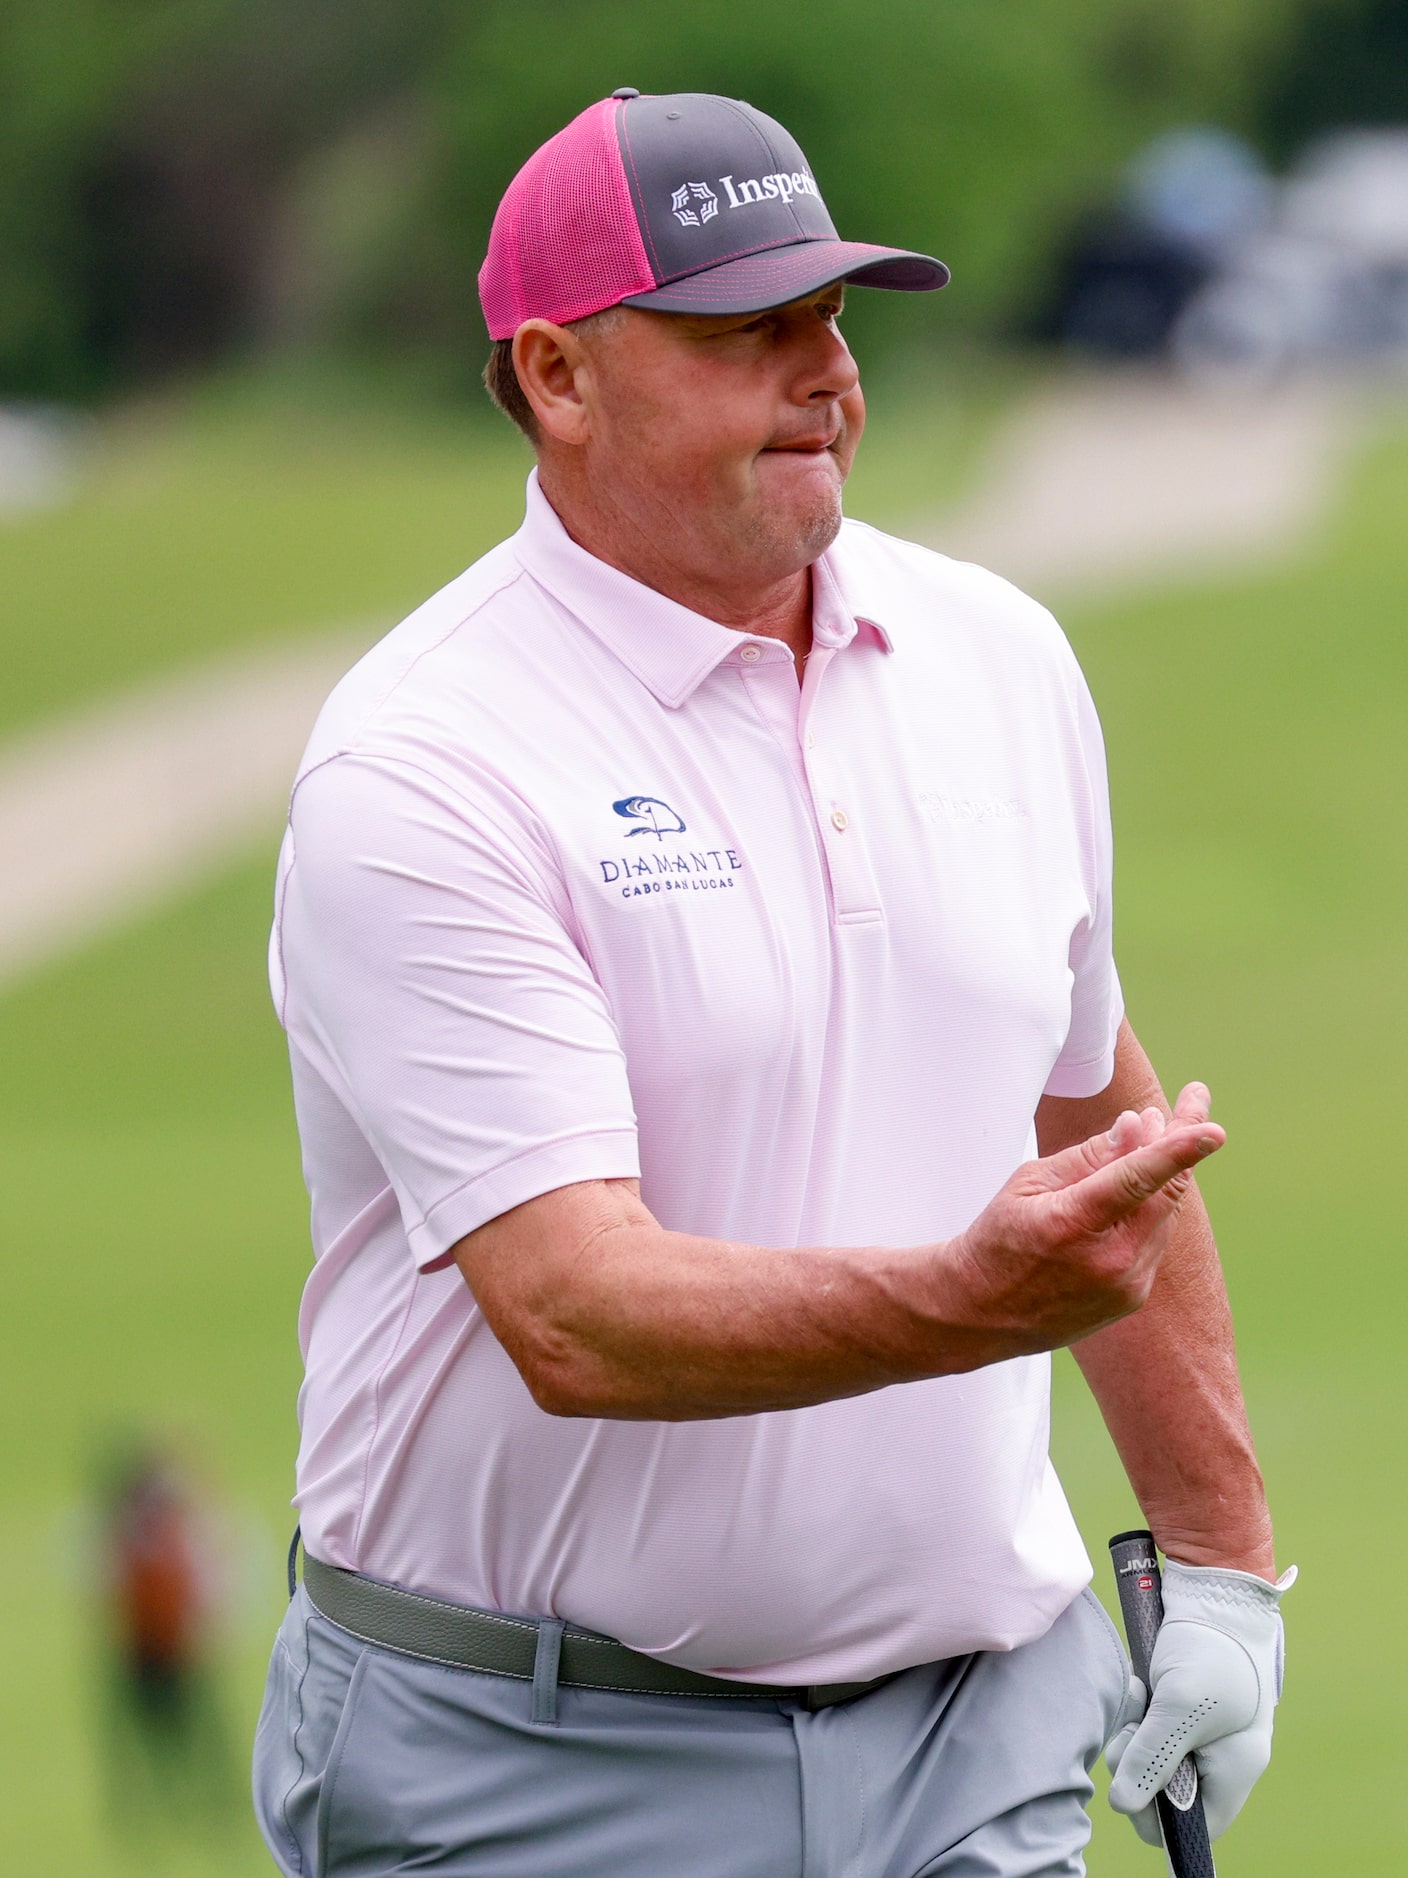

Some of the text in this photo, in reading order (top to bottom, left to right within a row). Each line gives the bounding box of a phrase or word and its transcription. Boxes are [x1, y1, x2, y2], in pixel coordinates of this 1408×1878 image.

[600, 850, 743, 883] DIAMANTE
[622, 878, 734, 898] CABO SAN LUCAS
